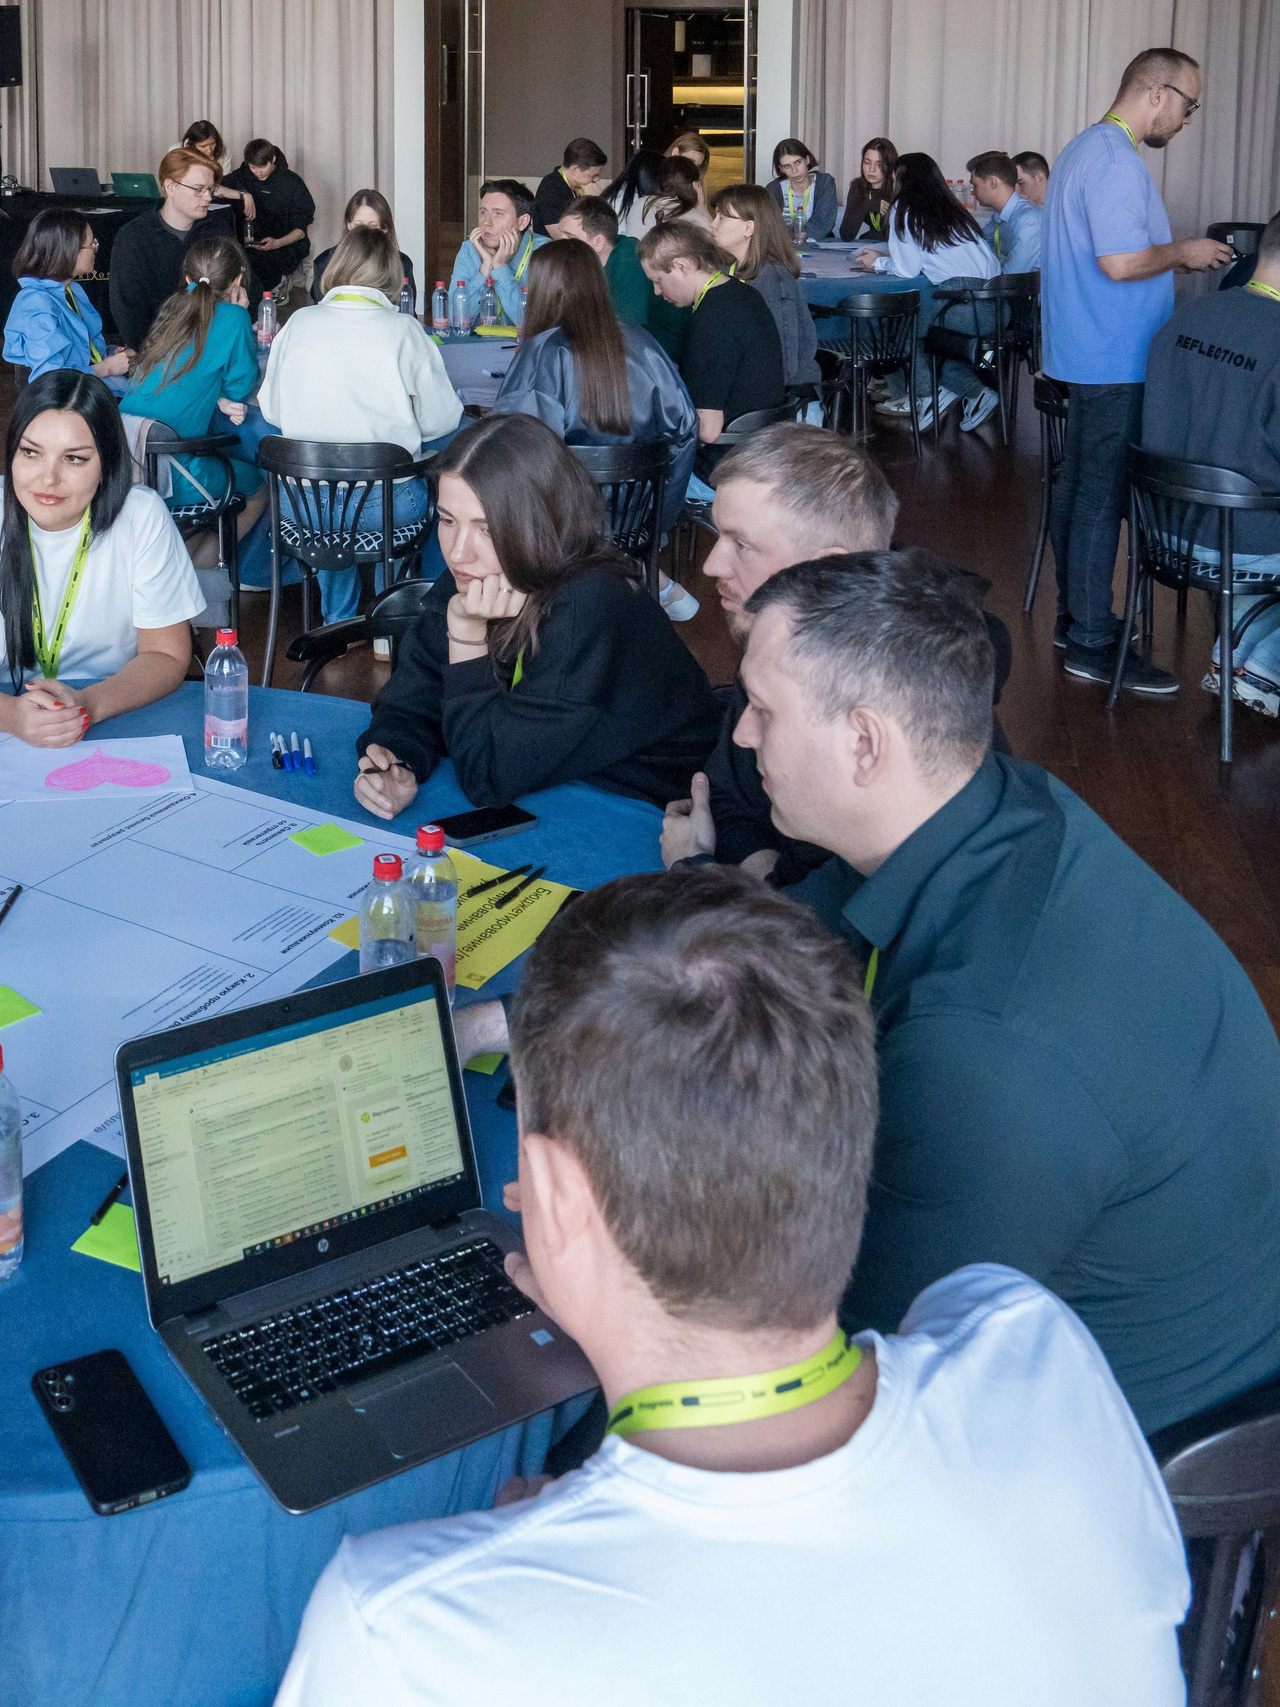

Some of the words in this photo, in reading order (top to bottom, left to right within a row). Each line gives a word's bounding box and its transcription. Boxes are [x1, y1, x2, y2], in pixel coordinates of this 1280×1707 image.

[1175, 334, 1259, 372] REFLECTION
[456, 887, 552, 963] Бюджетирование/п
[219, 978, 248, 997] Какую
[180, 995, 221, 1022] проблему
